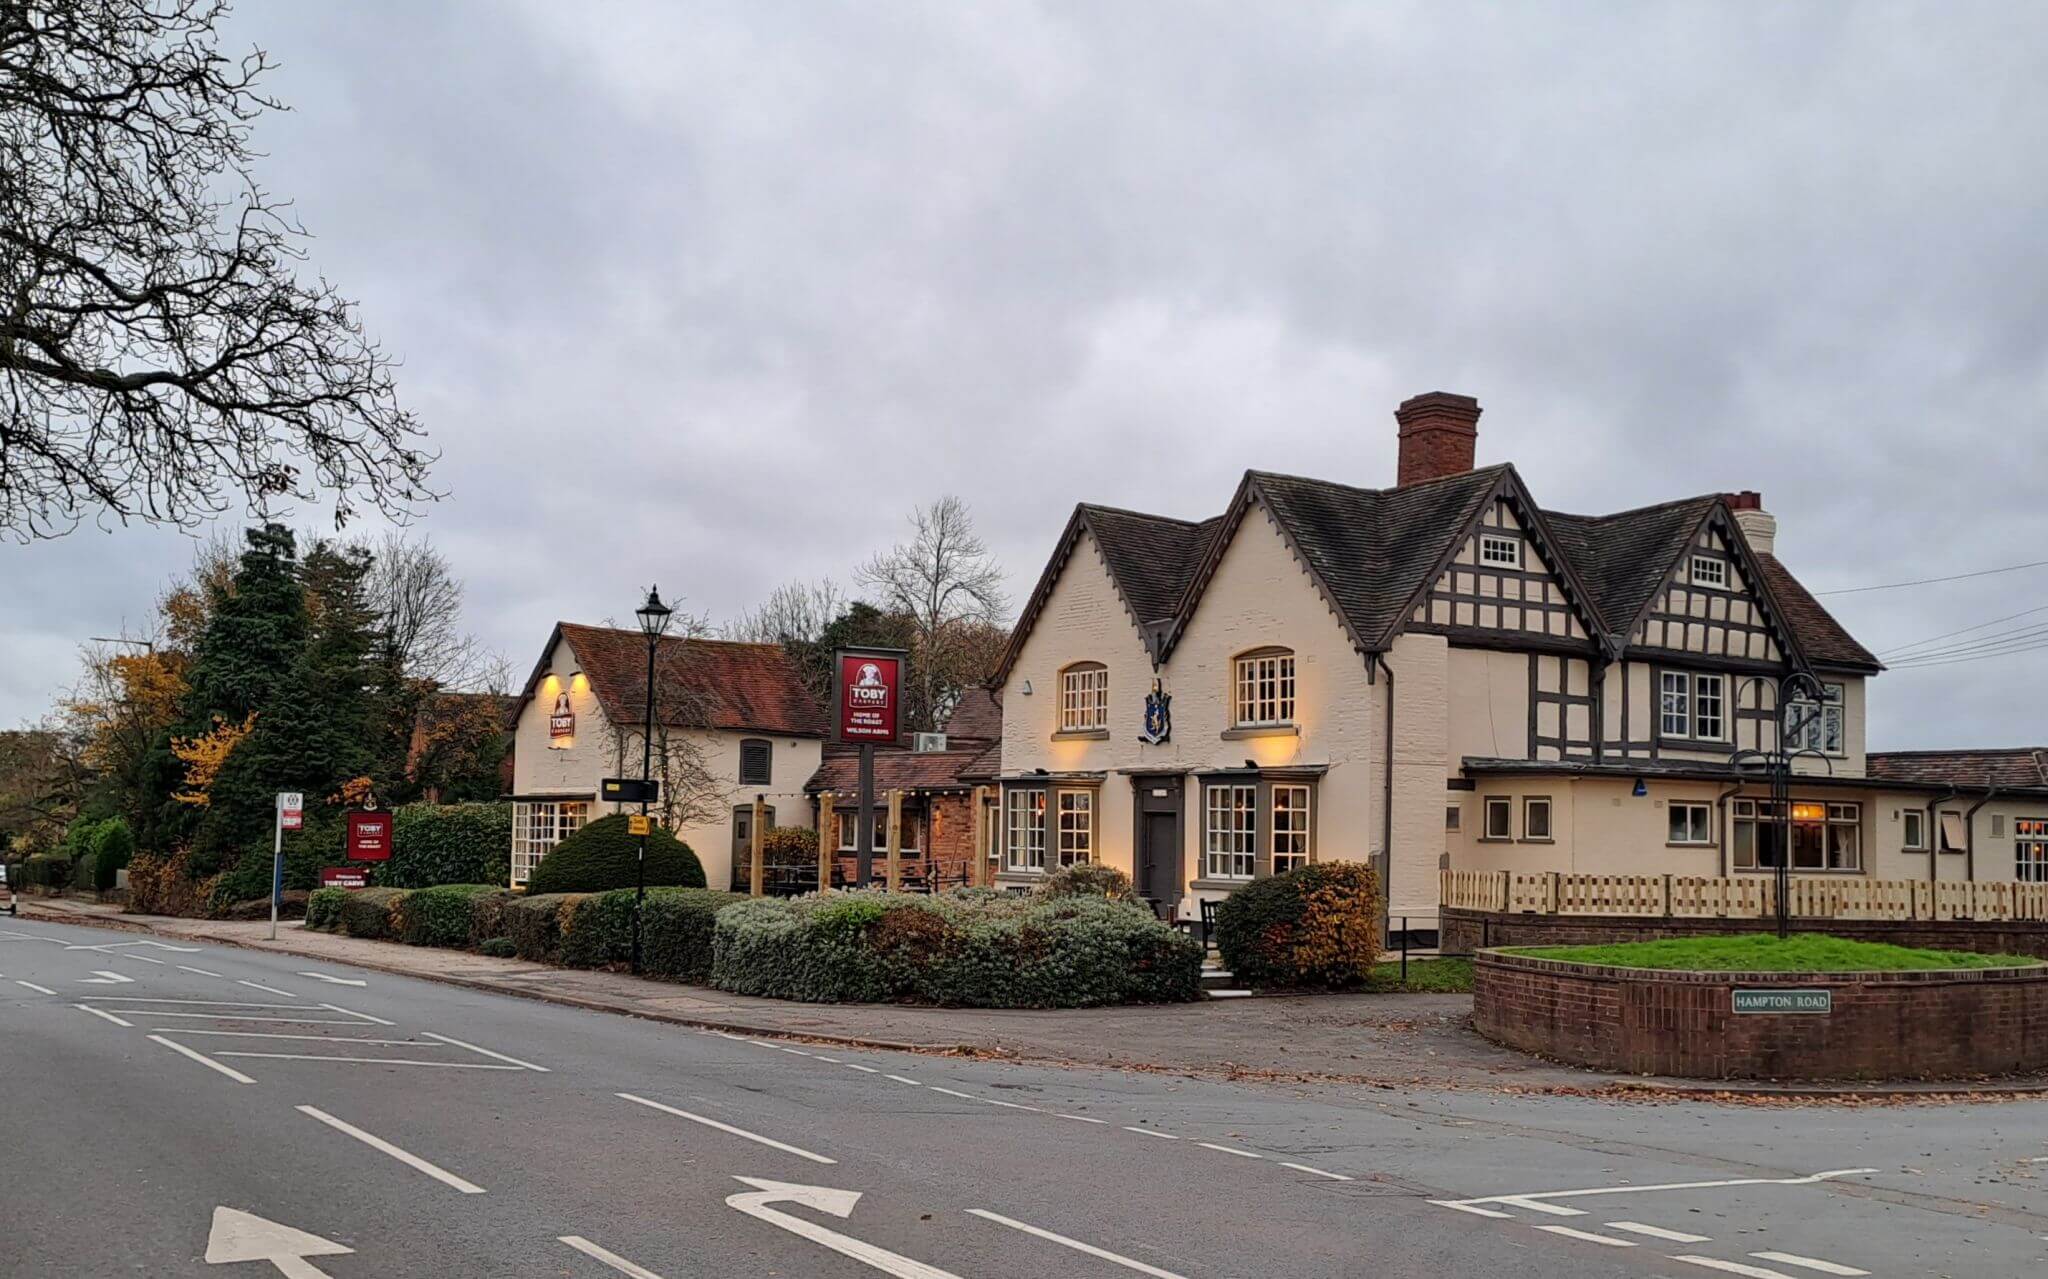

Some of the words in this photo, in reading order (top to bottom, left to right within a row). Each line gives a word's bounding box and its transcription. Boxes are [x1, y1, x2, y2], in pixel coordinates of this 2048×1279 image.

[852, 688, 886, 699] TOBY
[551, 718, 571, 728] TOBY
[1736, 996, 1792, 1008] HAMPTON
[1796, 996, 1827, 1008] ROAD
